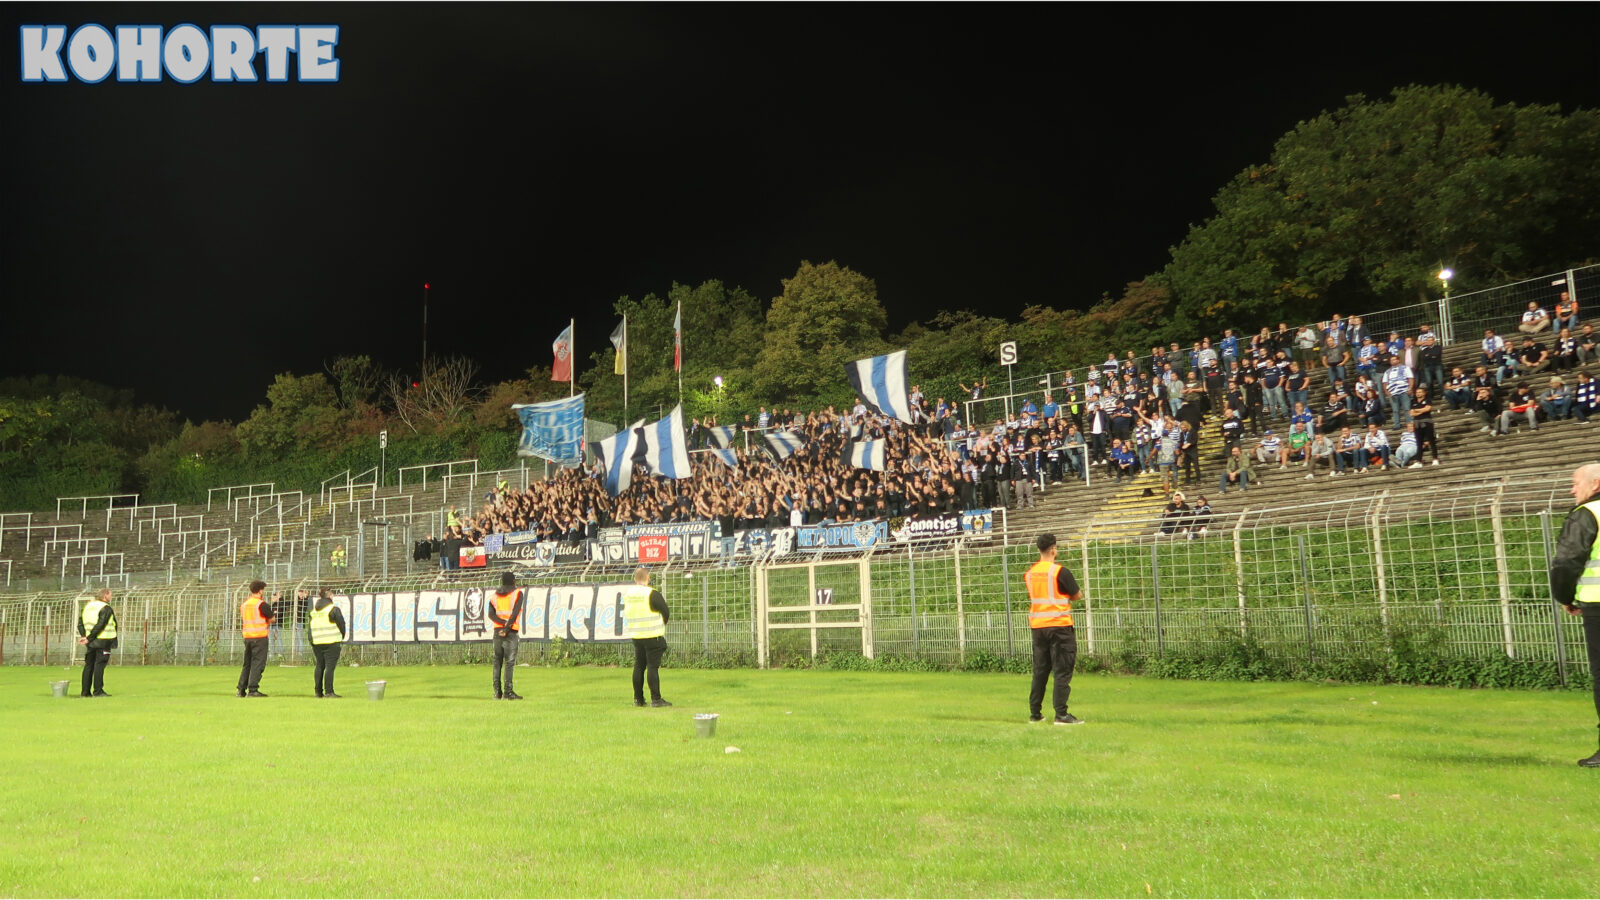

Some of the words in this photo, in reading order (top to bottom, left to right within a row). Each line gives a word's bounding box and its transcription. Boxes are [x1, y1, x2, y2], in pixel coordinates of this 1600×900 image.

[1002, 344, 1016, 363] S
[521, 543, 582, 559] Getion
[590, 535, 722, 562] KOHRTE
[641, 538, 667, 548] ULTRAS
[817, 589, 832, 605] 17
